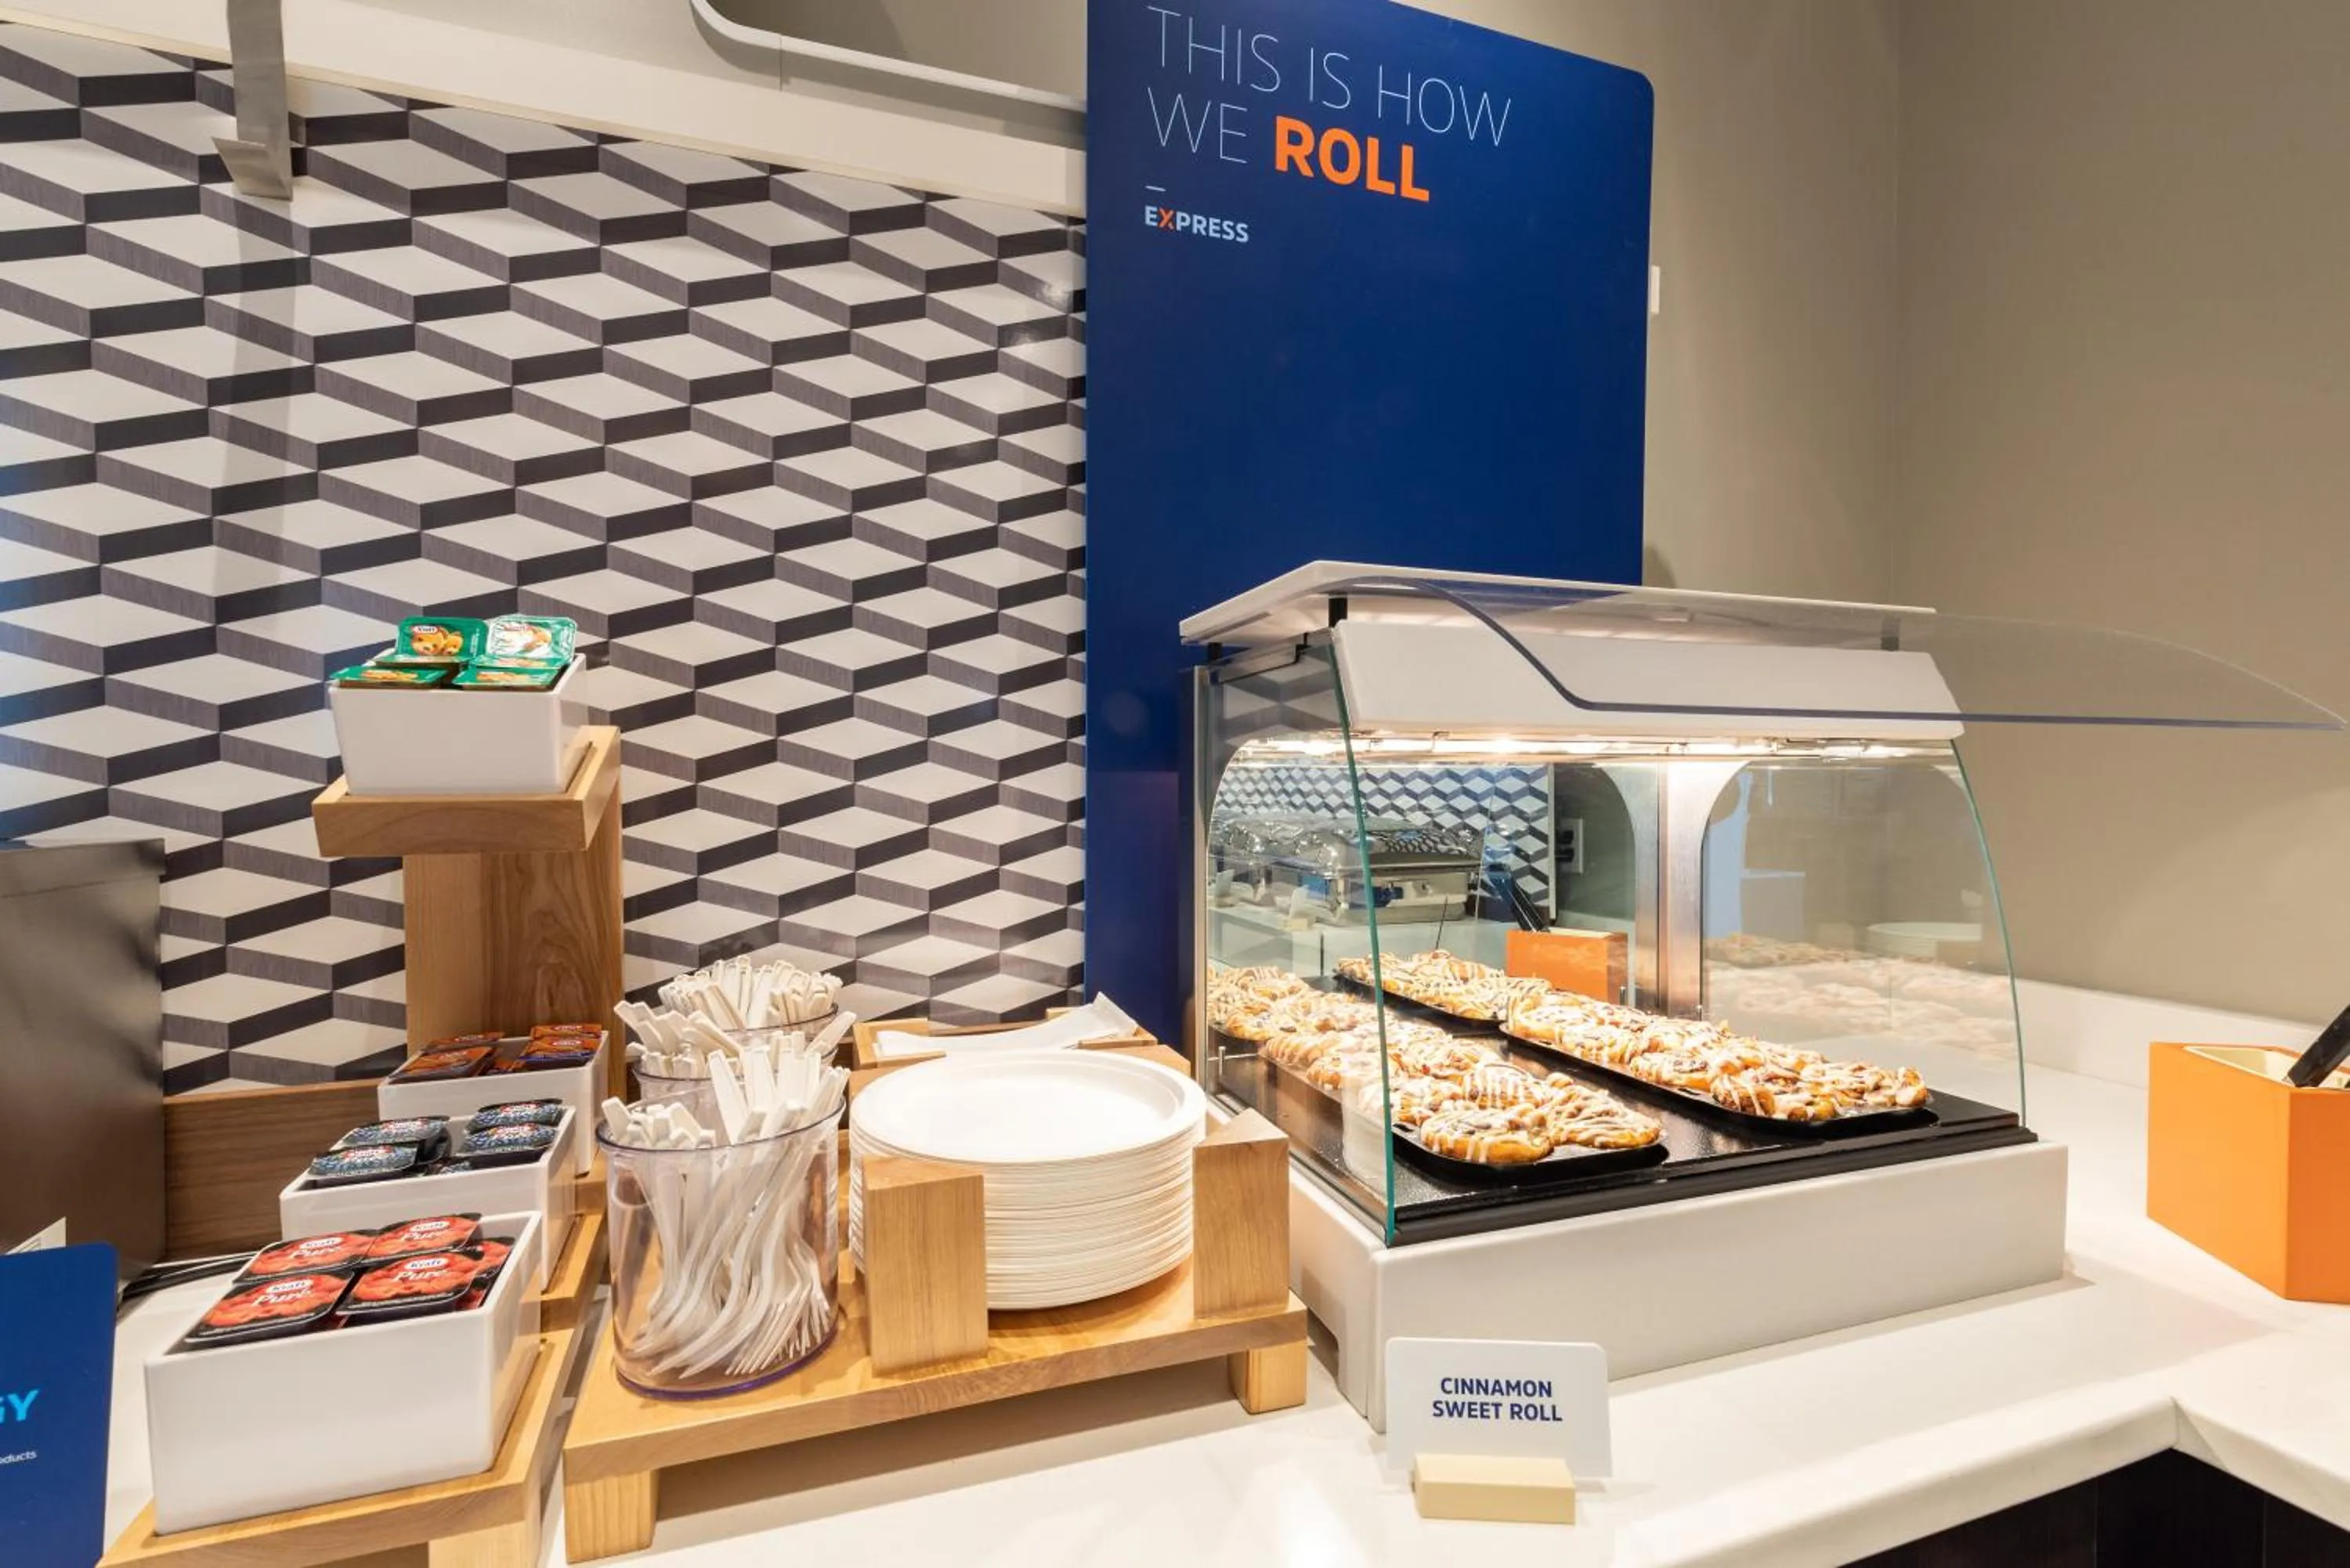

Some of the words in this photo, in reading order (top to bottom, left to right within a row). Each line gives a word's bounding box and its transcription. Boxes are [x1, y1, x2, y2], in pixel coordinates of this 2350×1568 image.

[1148, 5, 1280, 92] THIS
[1309, 47, 1351, 110] IS
[1378, 65, 1512, 147] HOW
[1147, 86, 1248, 164] WE
[1274, 114, 1430, 203] ROLL
[1144, 204, 1249, 244] EXPRESS
[0, 1389, 38, 1423] Y
[1440, 1377, 1553, 1398] CINNAMON
[1432, 1400, 1502, 1420] SWEET
[1509, 1404, 1563, 1422] ROLL
